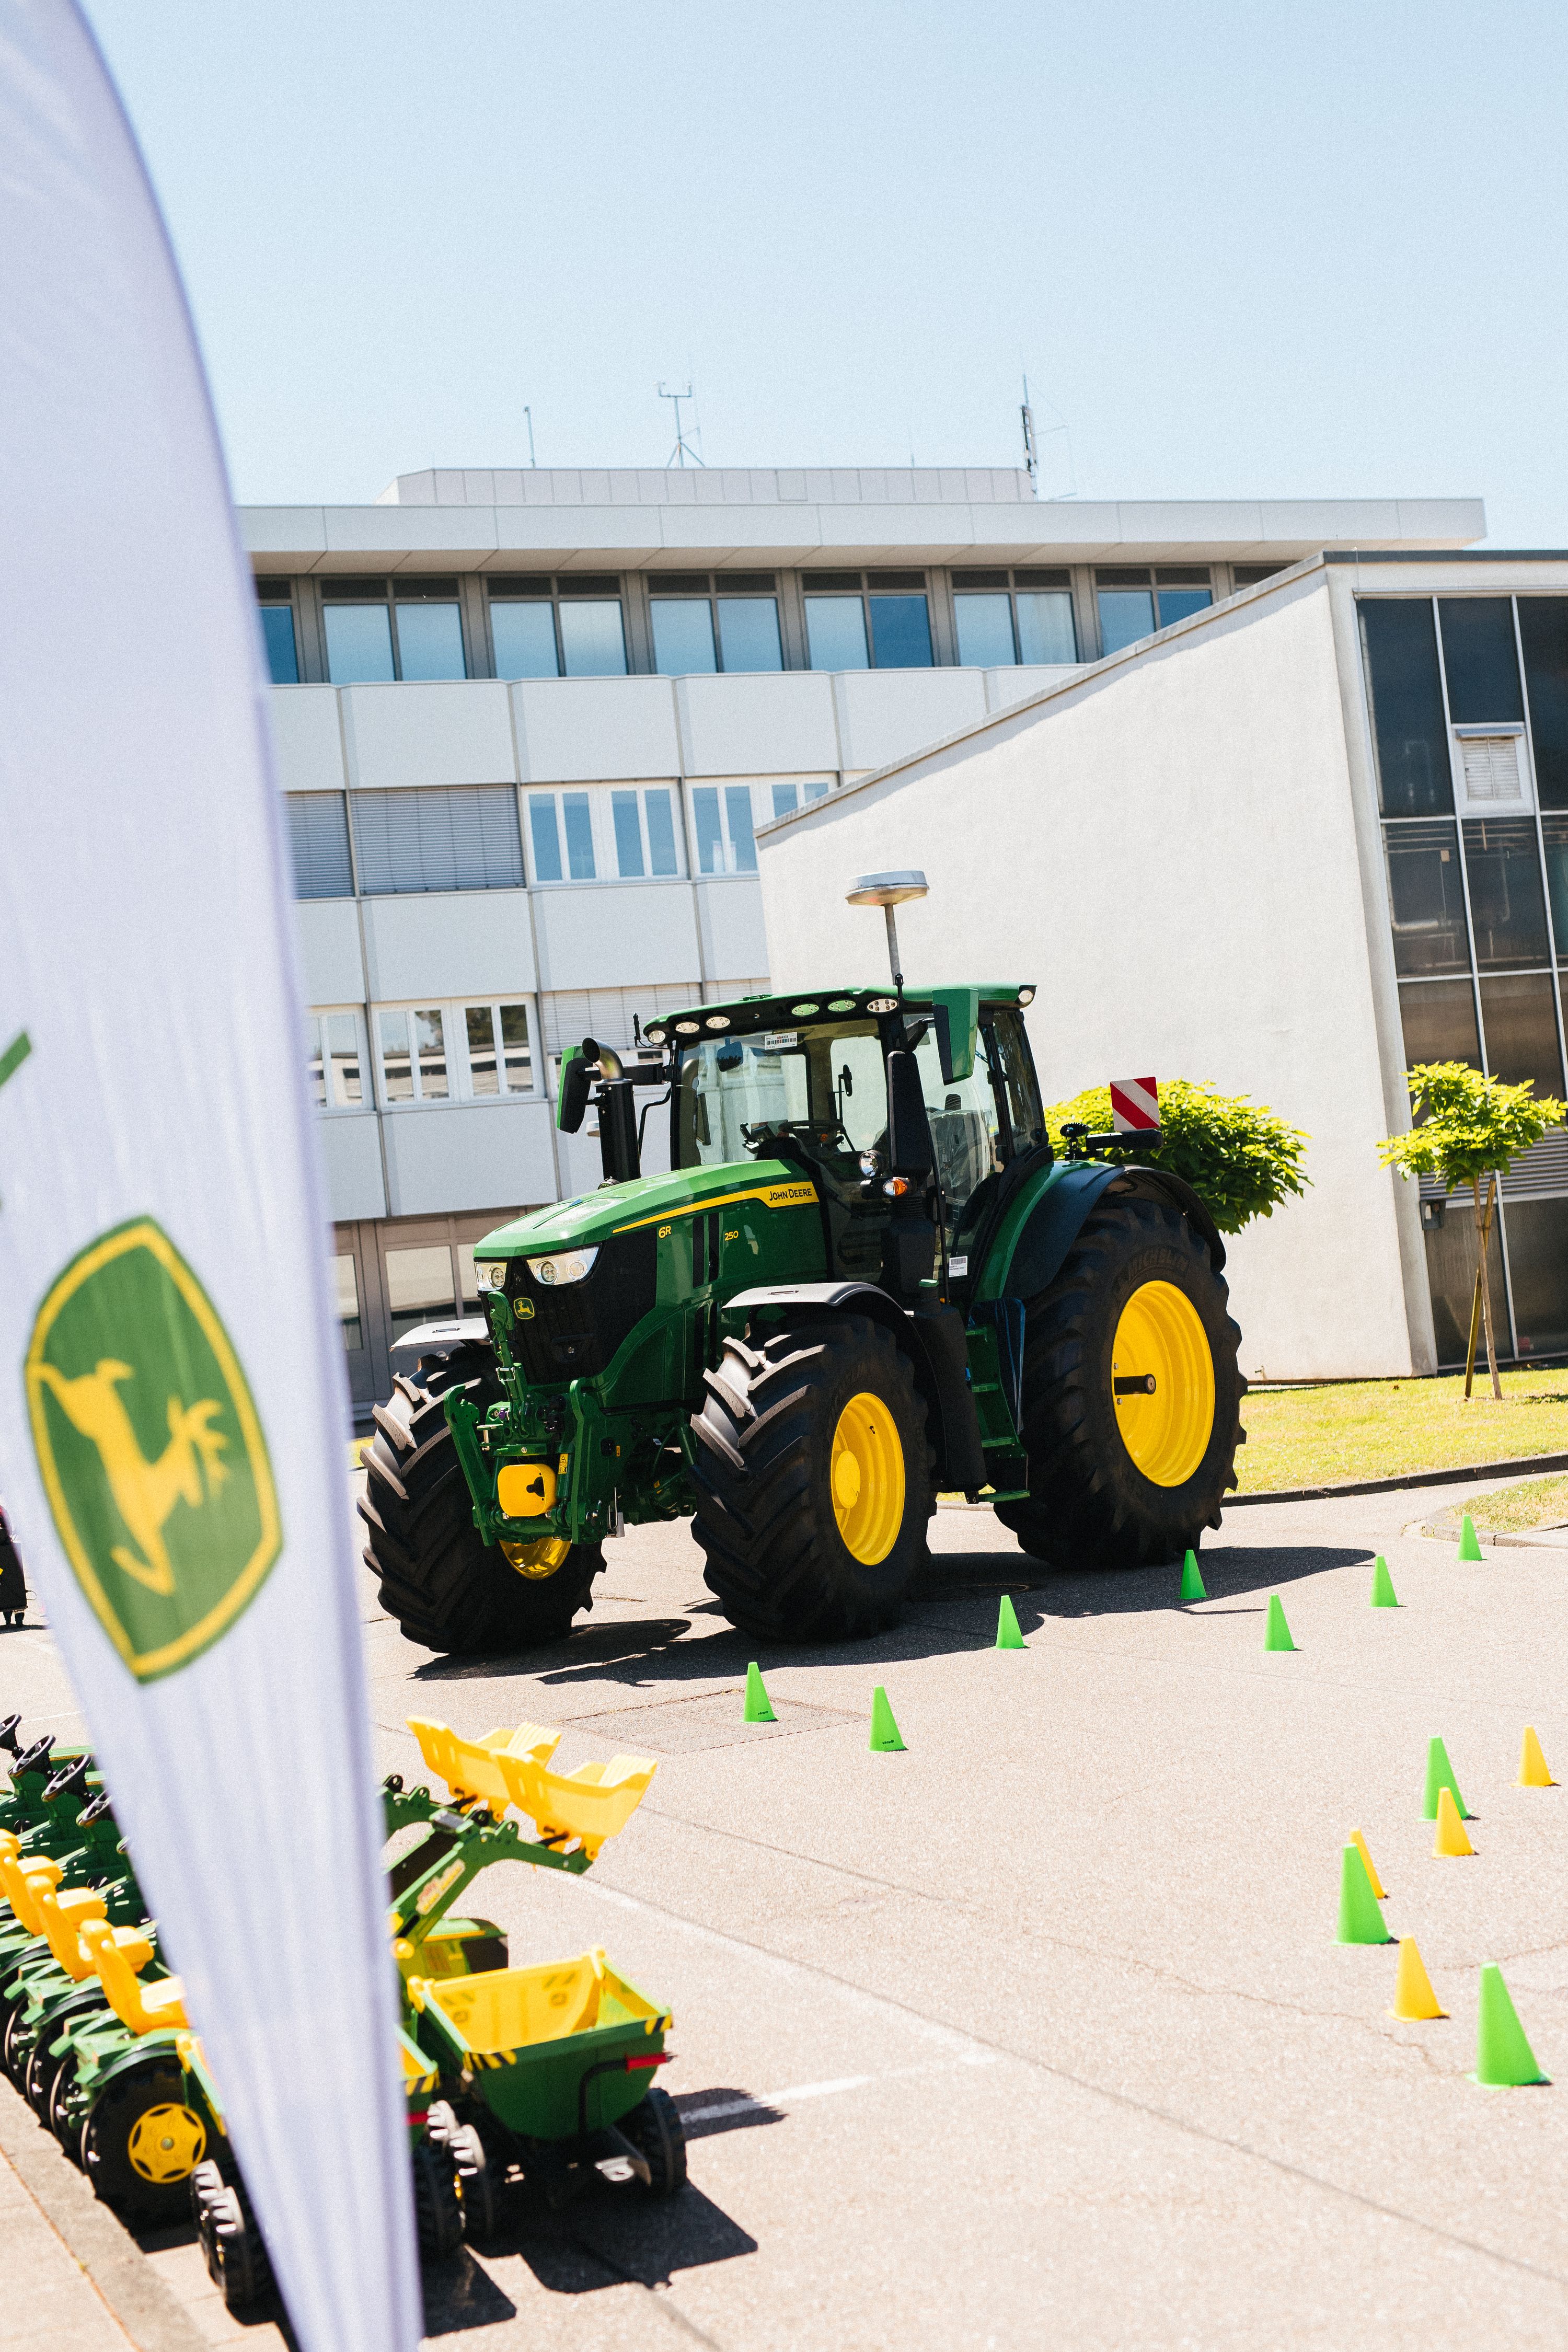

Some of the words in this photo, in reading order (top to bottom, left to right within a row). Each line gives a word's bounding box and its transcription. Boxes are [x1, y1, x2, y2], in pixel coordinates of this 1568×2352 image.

[769, 1191, 788, 1201] JOHN
[788, 1188, 812, 1198] DEERE
[659, 1225, 672, 1239] 6R
[724, 1230, 739, 1241] 250
